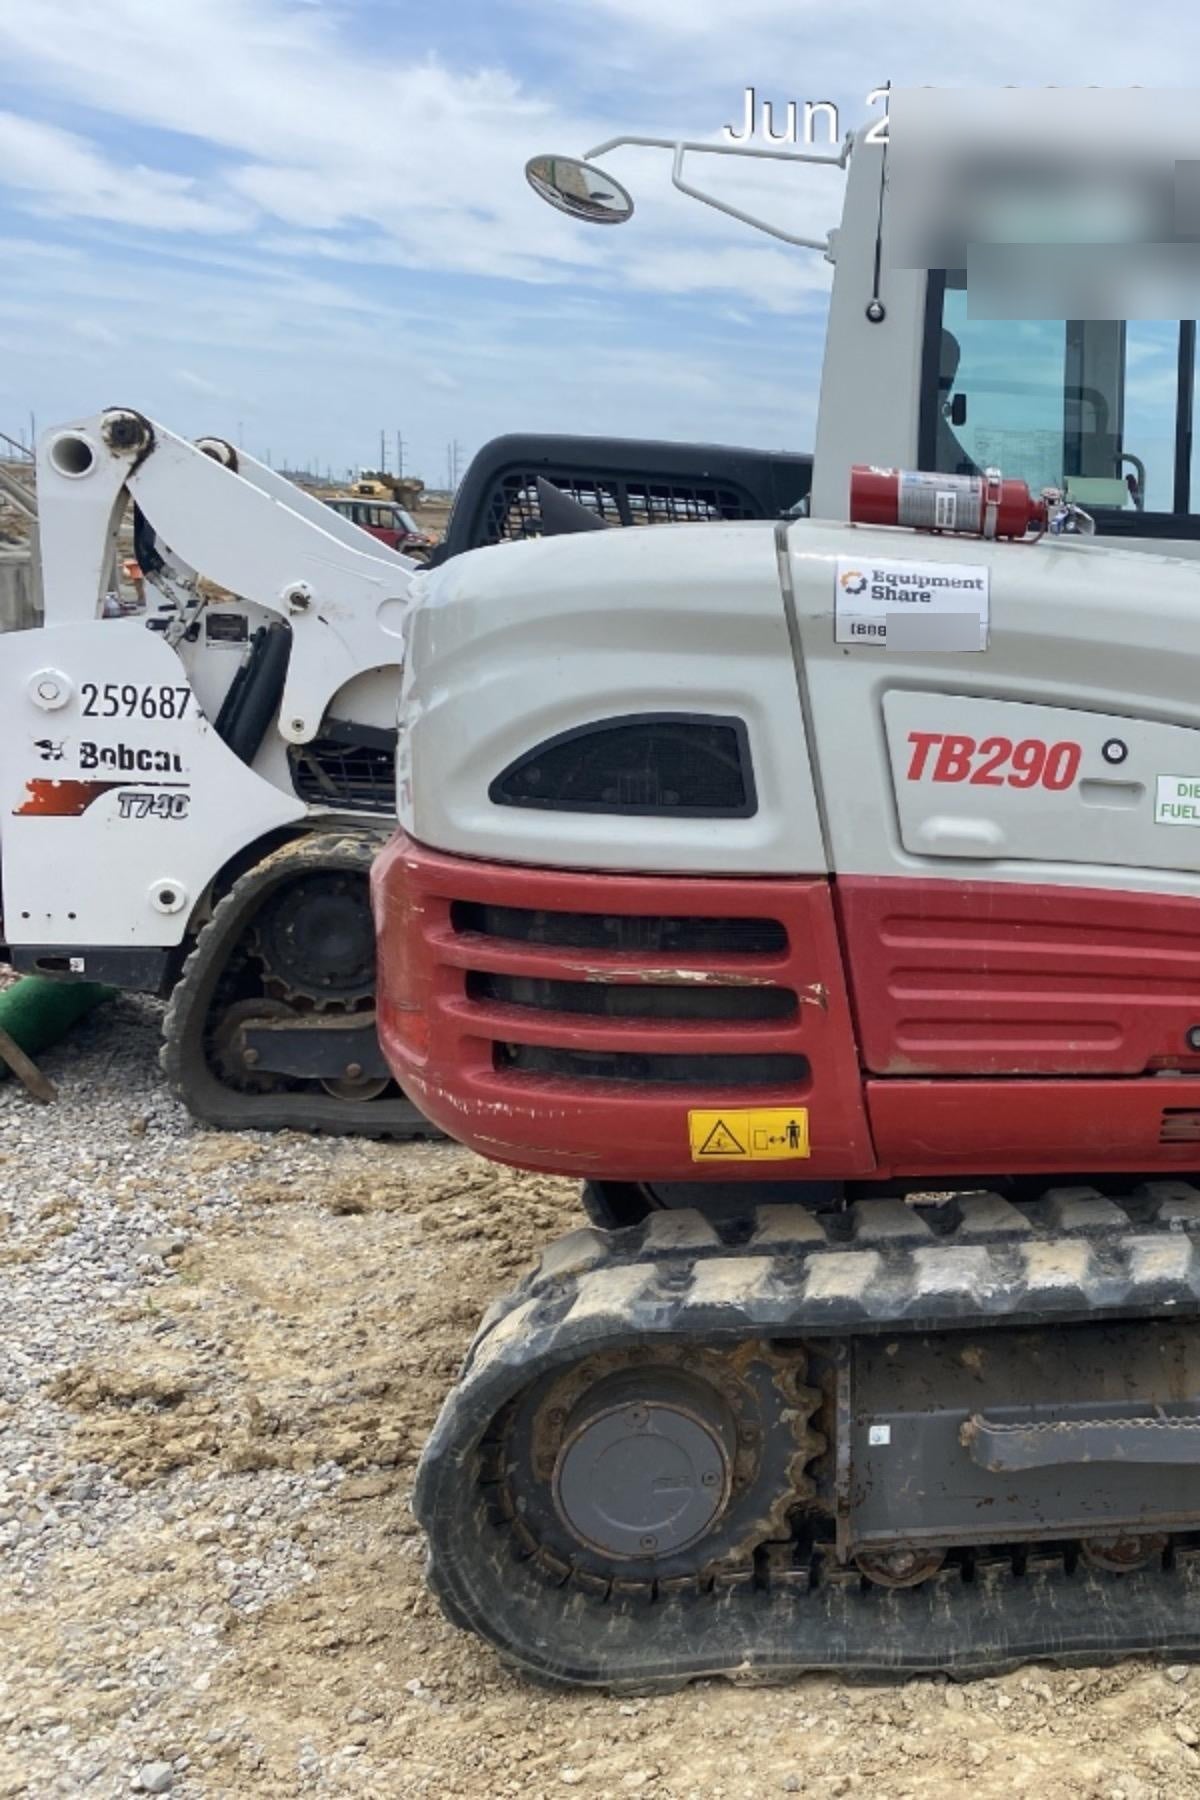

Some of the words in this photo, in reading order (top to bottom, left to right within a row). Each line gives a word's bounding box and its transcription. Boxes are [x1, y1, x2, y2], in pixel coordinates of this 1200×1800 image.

[872, 570, 984, 590] Equipment
[872, 585, 932, 603] Share
[81, 683, 191, 720] 259687
[79, 741, 183, 773] Bobcat
[907, 732, 1082, 791] TB290
[117, 791, 191, 819] T740
[1160, 803, 1200, 820] FUEL
